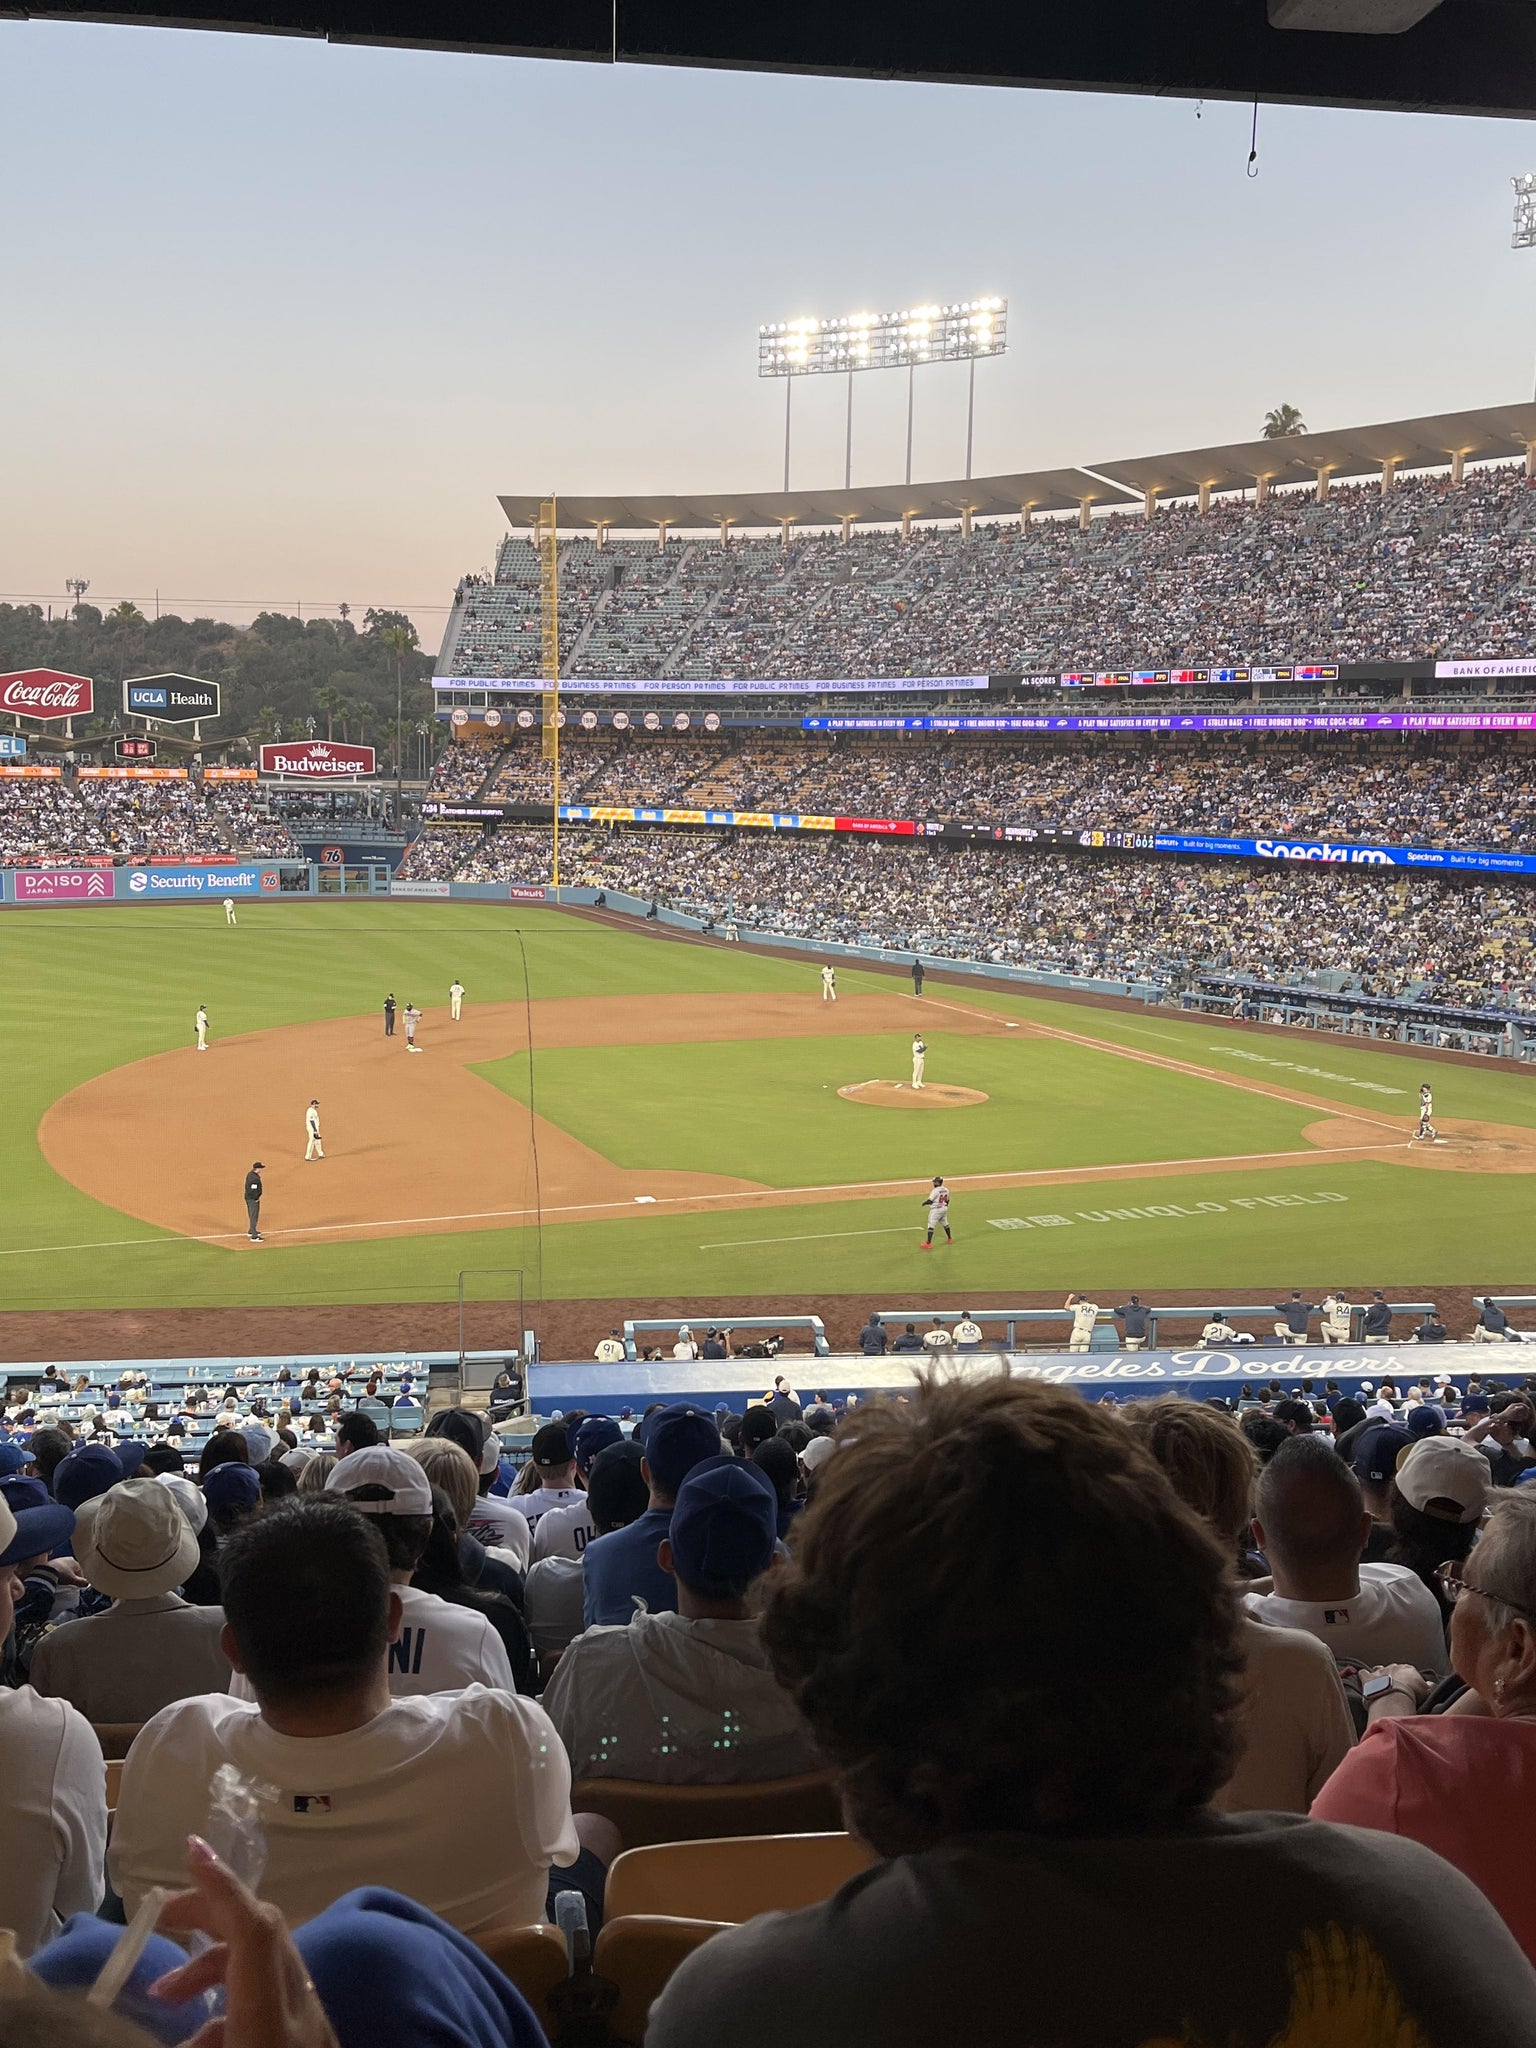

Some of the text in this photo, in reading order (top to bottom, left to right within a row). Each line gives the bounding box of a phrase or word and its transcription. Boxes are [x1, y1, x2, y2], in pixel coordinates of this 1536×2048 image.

[1453, 667, 1480, 675] BANK
[1483, 666, 1496, 674] OF
[468, 679, 498, 687] PUBLIC
[562, 681, 600, 689] BUSINESS
[902, 680, 915, 688] FOR
[1021, 677, 1030, 685] AL
[1031, 676, 1056, 685] SCORES
[733, 682, 749, 690] FOR
[750, 682, 775, 690] PUBLIC
[816, 682, 830, 690] FOR
[3, 680, 84, 707] Coca-Cola
[133, 692, 213, 706] UCLA Health
[518, 715, 533, 723] 1963
[1078, 719, 1171, 727] A PLAY THAT SATISFIES IN EVERY WAY
[1208, 718, 1228, 726] STOLEN
[1229, 718, 1243, 726] BASE
[1253, 718, 1267, 726] FREE
[1268, 718, 1292, 726] DODGER
[1402, 717, 1532, 726] A PLAY THAT SATISFIES IN EVERY WAY
[421, 803, 438, 814] 7:34
[1205, 841, 1214, 850] big
[324, 850, 340, 863] 76
[1407, 851, 1524, 867] Spectrum Built for big moments
[25, 875, 83, 887] DAISO
[150, 874, 205, 890] Security
[262, 874, 277, 886] 76
[511, 888, 545, 898] Yakult
[1075, 1192, 1349, 1222] UNIQLO FIELD
[1081, 1305, 1095, 1315] 86
[1335, 1305, 1350, 1315] 84
[962, 1324, 977, 1335] 68
[1210, 1326, 1223, 1336] 21
[931, 1334, 946, 1344] 72
[603, 1343, 615, 1355] 91
[1171, 1350, 1405, 1378] Dodgers
